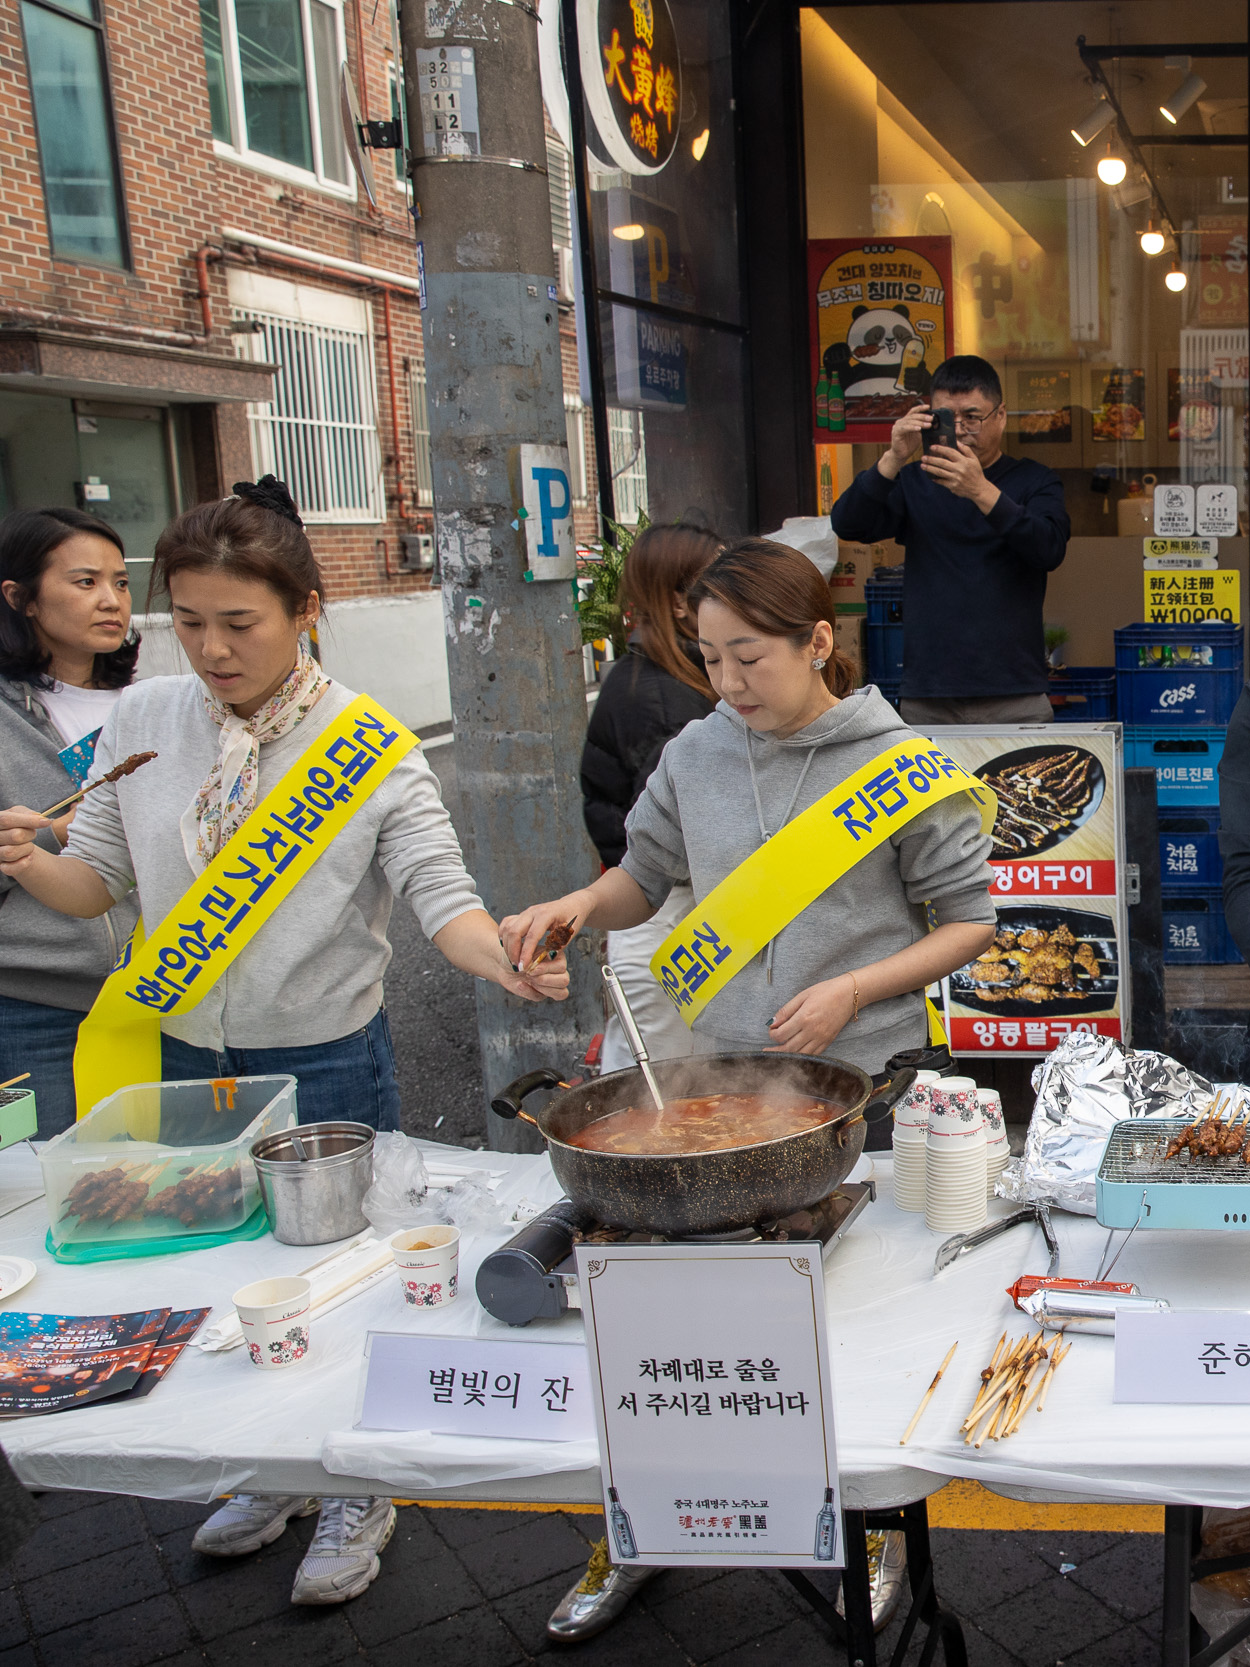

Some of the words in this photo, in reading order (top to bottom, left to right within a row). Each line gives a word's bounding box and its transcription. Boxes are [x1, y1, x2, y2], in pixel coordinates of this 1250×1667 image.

[837, 263, 866, 282] 건대
[869, 263, 922, 280] 양꼬치엔
[817, 283, 862, 308] 무조건
[867, 281, 945, 306] 칭따오지!
[641, 321, 681, 357] PARKING
[532, 466, 570, 557] P
[1149, 577, 1215, 591] 新人注册
[1149, 592, 1215, 606] 立领红包
[1166, 842, 1198, 858] 처음
[125, 711, 399, 1013] 건대양꼬치거리상인회
[1166, 858, 1198, 872] 처럼
[1168, 923, 1197, 938] 처음
[1169, 936, 1200, 948] 처럼
[639, 1358, 729, 1383] 차례대로
[734, 1358, 780, 1382] 줄을
[429, 1367, 521, 1409] 별빛의
[541, 1376, 574, 1412] 잔
[617, 1392, 638, 1416] 서
[645, 1392, 712, 1416] 주시길
[718, 1391, 809, 1416] 바랍니다
[674, 1499, 693, 1509] 중국
[695, 1499, 729, 1509] 4대명주
[732, 1499, 769, 1509] 노주노교
